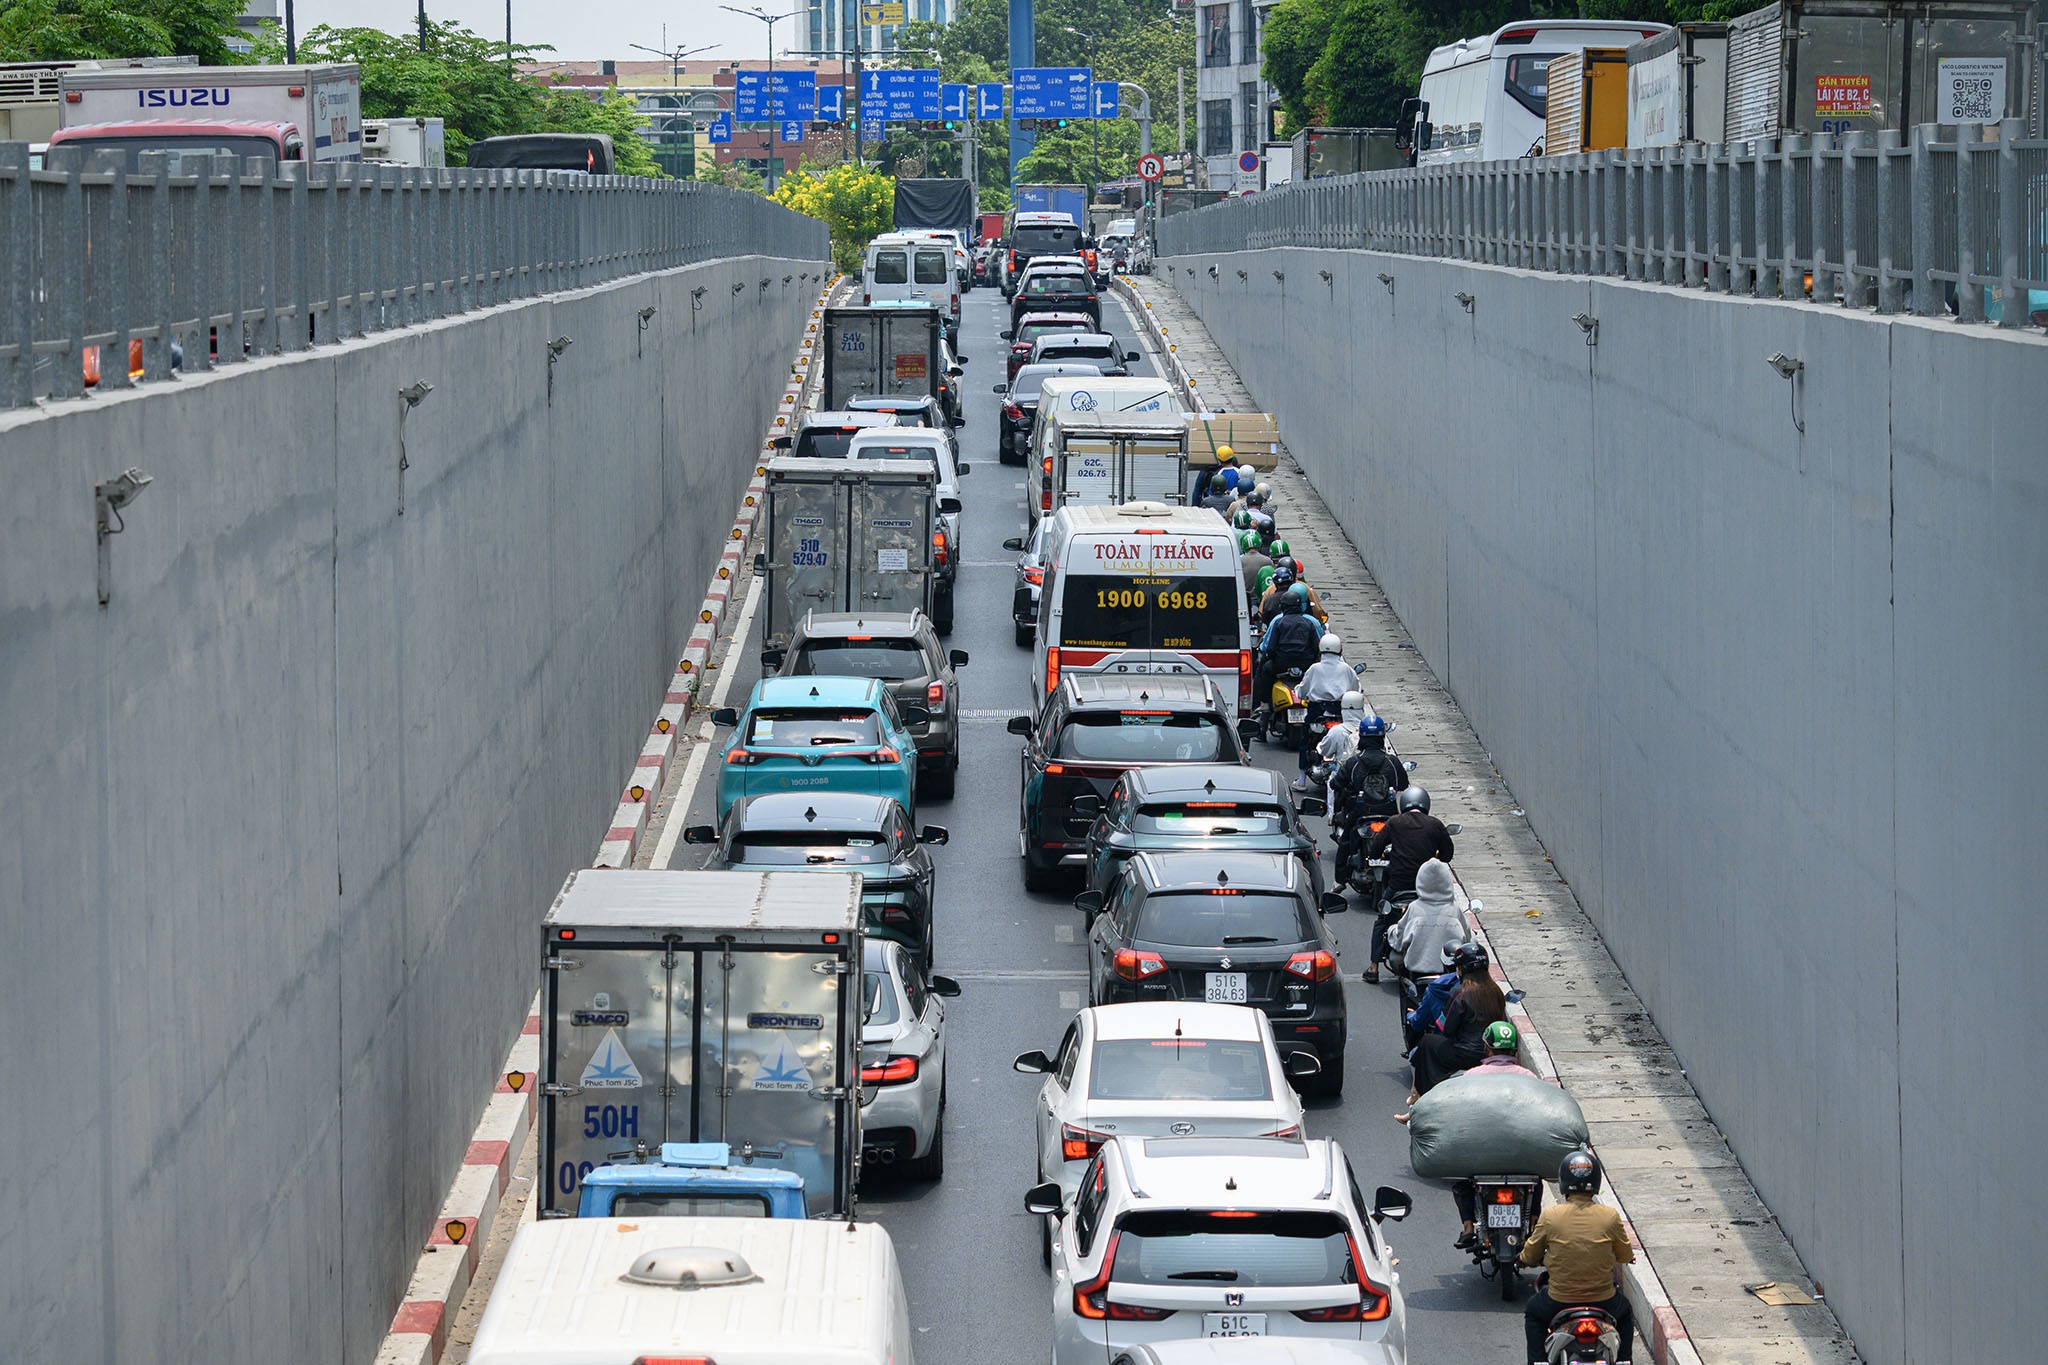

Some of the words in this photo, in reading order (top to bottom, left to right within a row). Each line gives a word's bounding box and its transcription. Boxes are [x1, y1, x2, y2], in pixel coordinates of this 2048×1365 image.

[139, 88, 230, 107] ISUZU
[1817, 86, 1831, 101] LÁI
[1833, 88, 1845, 101] XE
[1847, 88, 1861, 102] B2,
[1863, 88, 1869, 100] C
[843, 333, 861, 342] 54V
[841, 342, 865, 351] 7110
[1084, 459, 1103, 467] 62C.
[1094, 539, 1141, 559] TOÀN
[1152, 539, 1214, 559] THẮNG
[793, 552, 827, 566] 529.47
[1103, 561, 1196, 569] LIMOUSINE
[1097, 590, 1145, 608] 1900
[1158, 591, 1208, 609] 6968
[1215, 975, 1237, 987] 51G
[1207, 989, 1245, 1001] 384.63
[576, 1014, 625, 1024] THACO
[751, 1016, 820, 1026] FRONTIER
[583, 1105, 638, 1138] 50H
[1221, 1316, 1248, 1329] 61C
